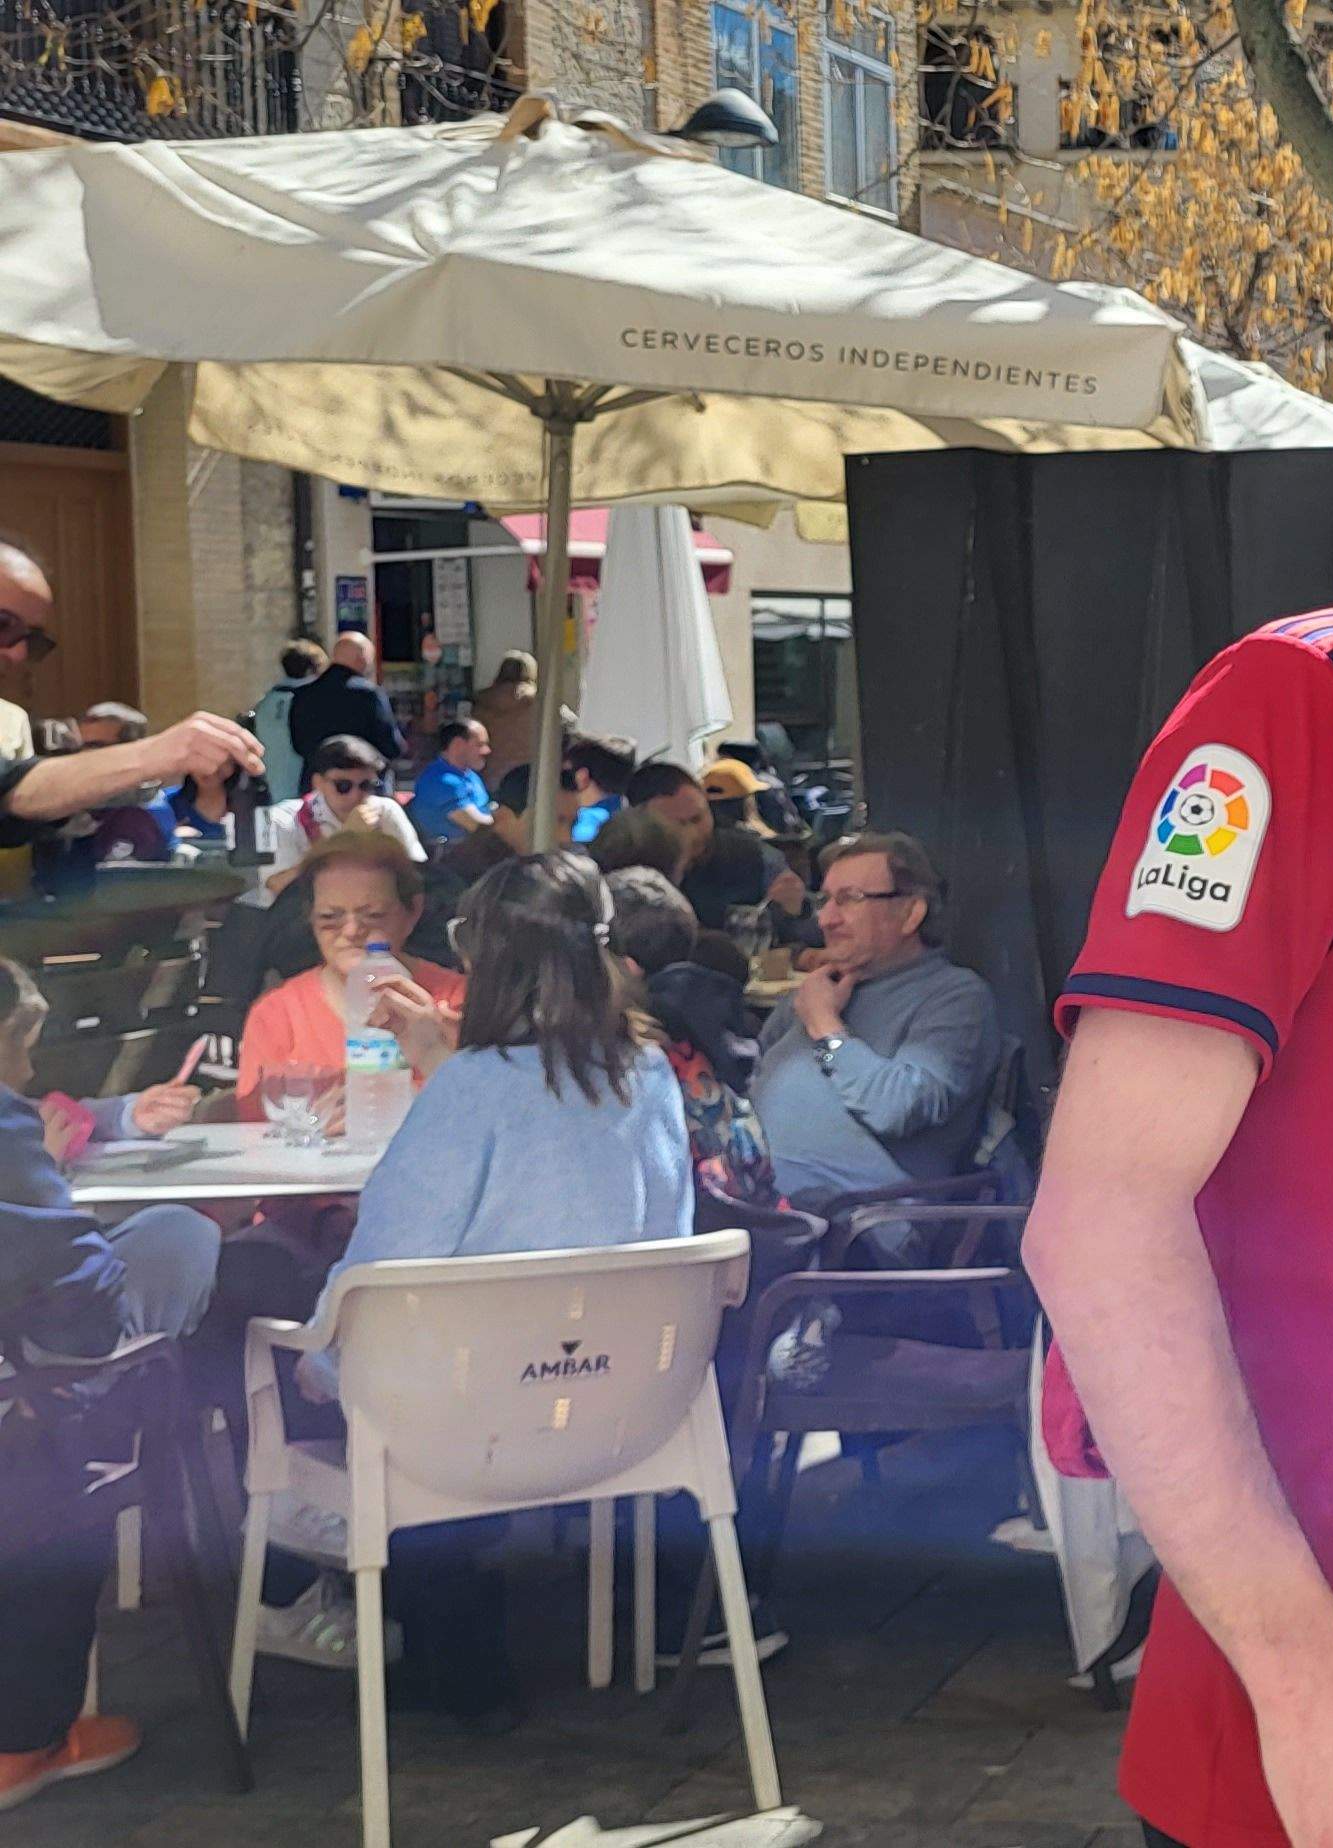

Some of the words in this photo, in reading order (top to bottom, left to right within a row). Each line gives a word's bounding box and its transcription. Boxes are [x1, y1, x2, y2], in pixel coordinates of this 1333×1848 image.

[620, 327, 825, 362] CERVECEROS
[839, 344, 1099, 396] INDEPENDIENTES
[1137, 863, 1232, 902] LaLiga
[520, 1354, 611, 1382] AMBAR
